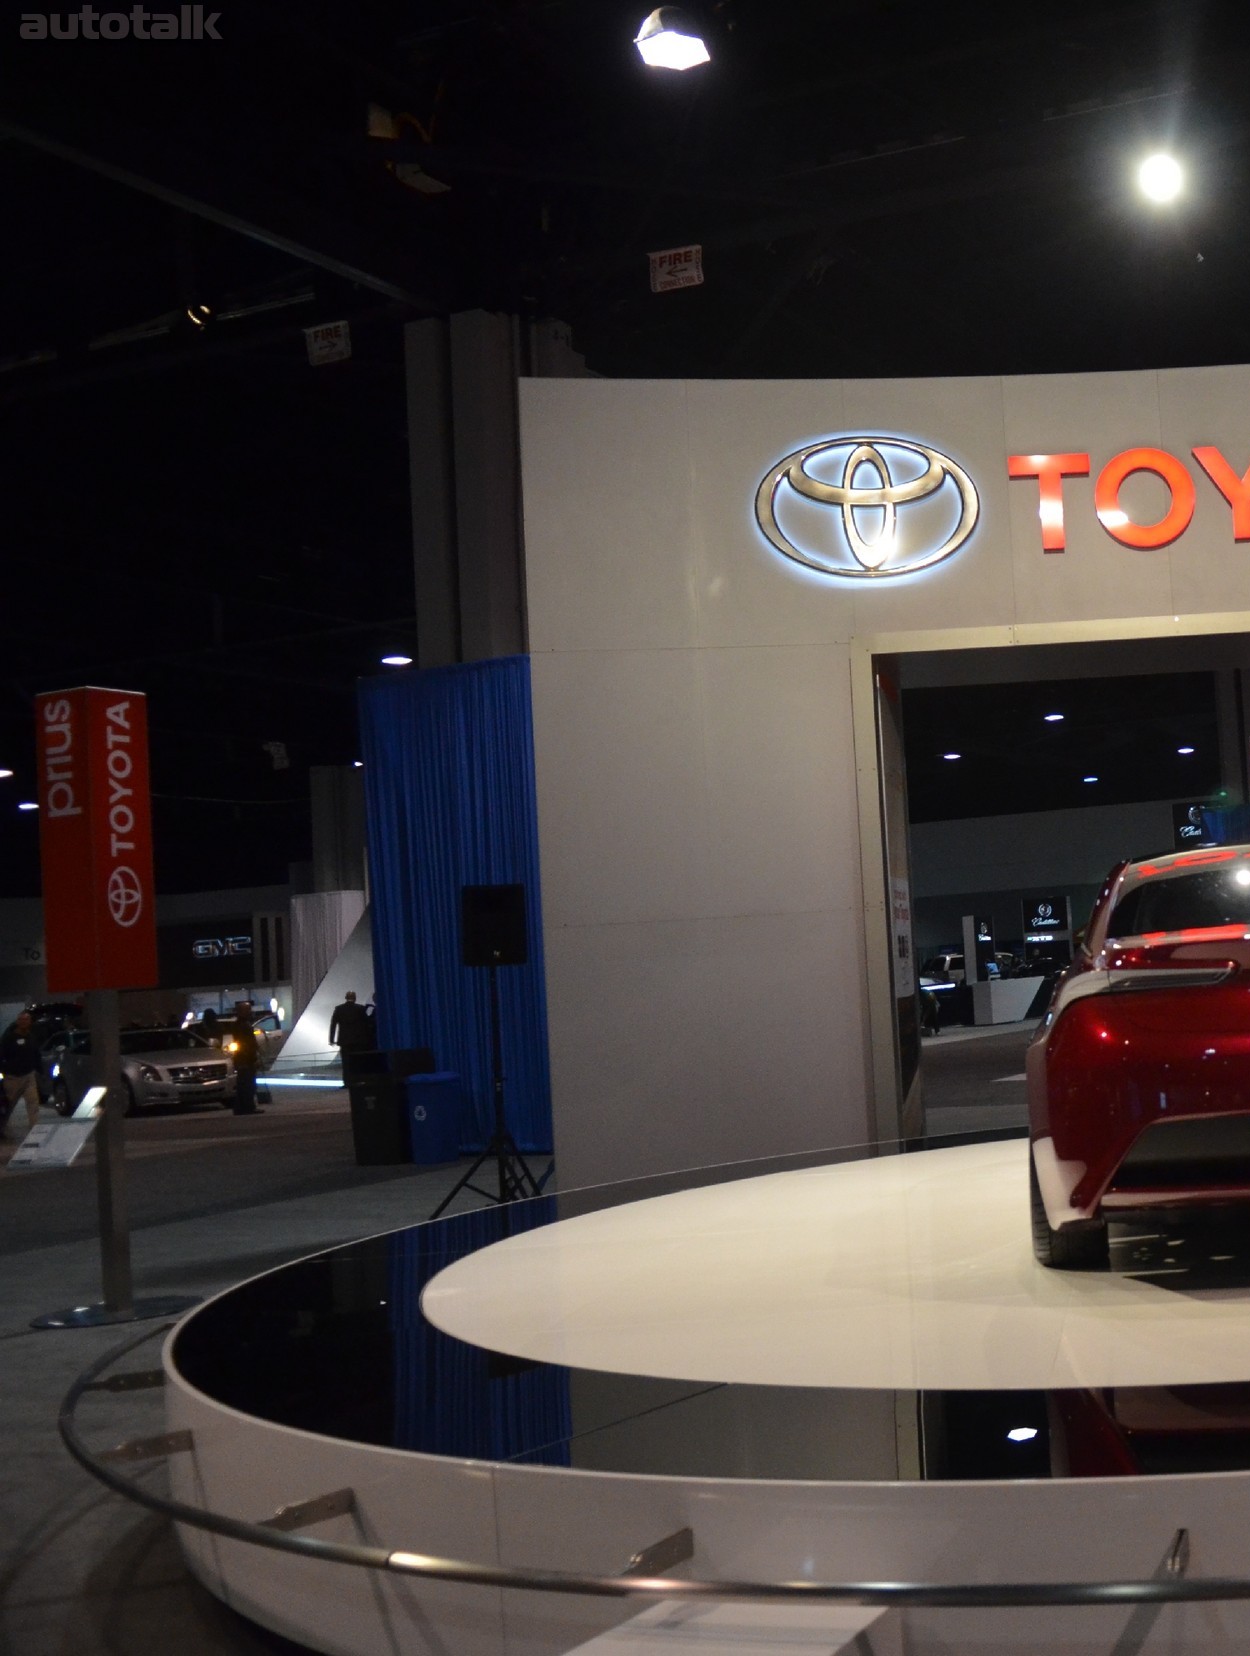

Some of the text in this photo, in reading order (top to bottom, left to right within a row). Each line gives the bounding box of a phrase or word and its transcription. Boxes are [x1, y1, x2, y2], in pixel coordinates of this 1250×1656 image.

[659, 251, 693, 268] FIRE
[313, 325, 342, 342] FIRE
[43, 699, 82, 818] prius
[105, 700, 136, 858] TOYOTA
[192, 936, 252, 959] GMC
